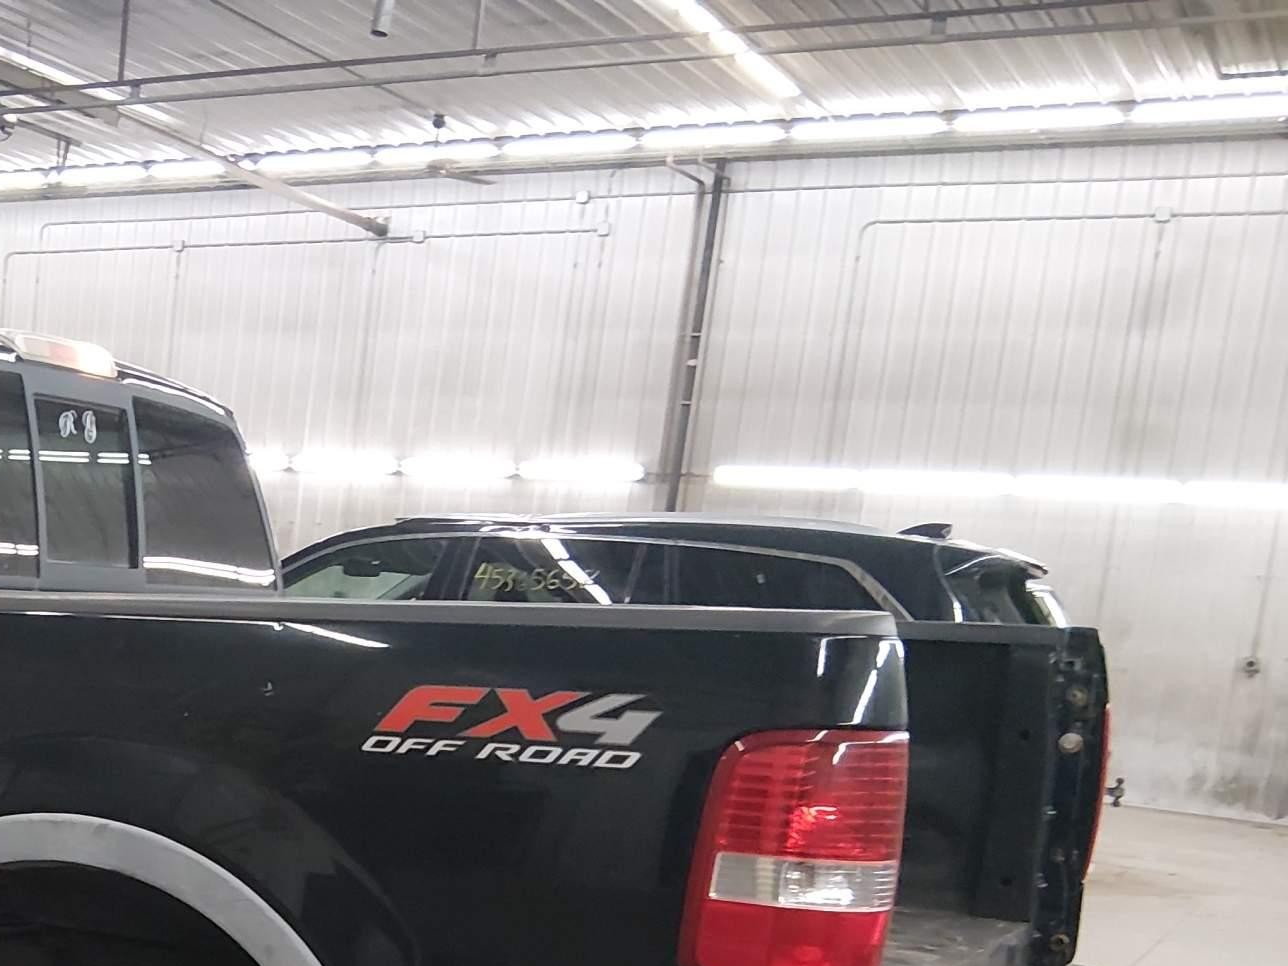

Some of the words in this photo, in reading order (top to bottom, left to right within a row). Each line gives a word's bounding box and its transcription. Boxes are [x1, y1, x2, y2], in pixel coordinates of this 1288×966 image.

[373, 684, 663, 745] FX4
[361, 734, 467, 757] OFF
[474, 741, 642, 769] ROAD
